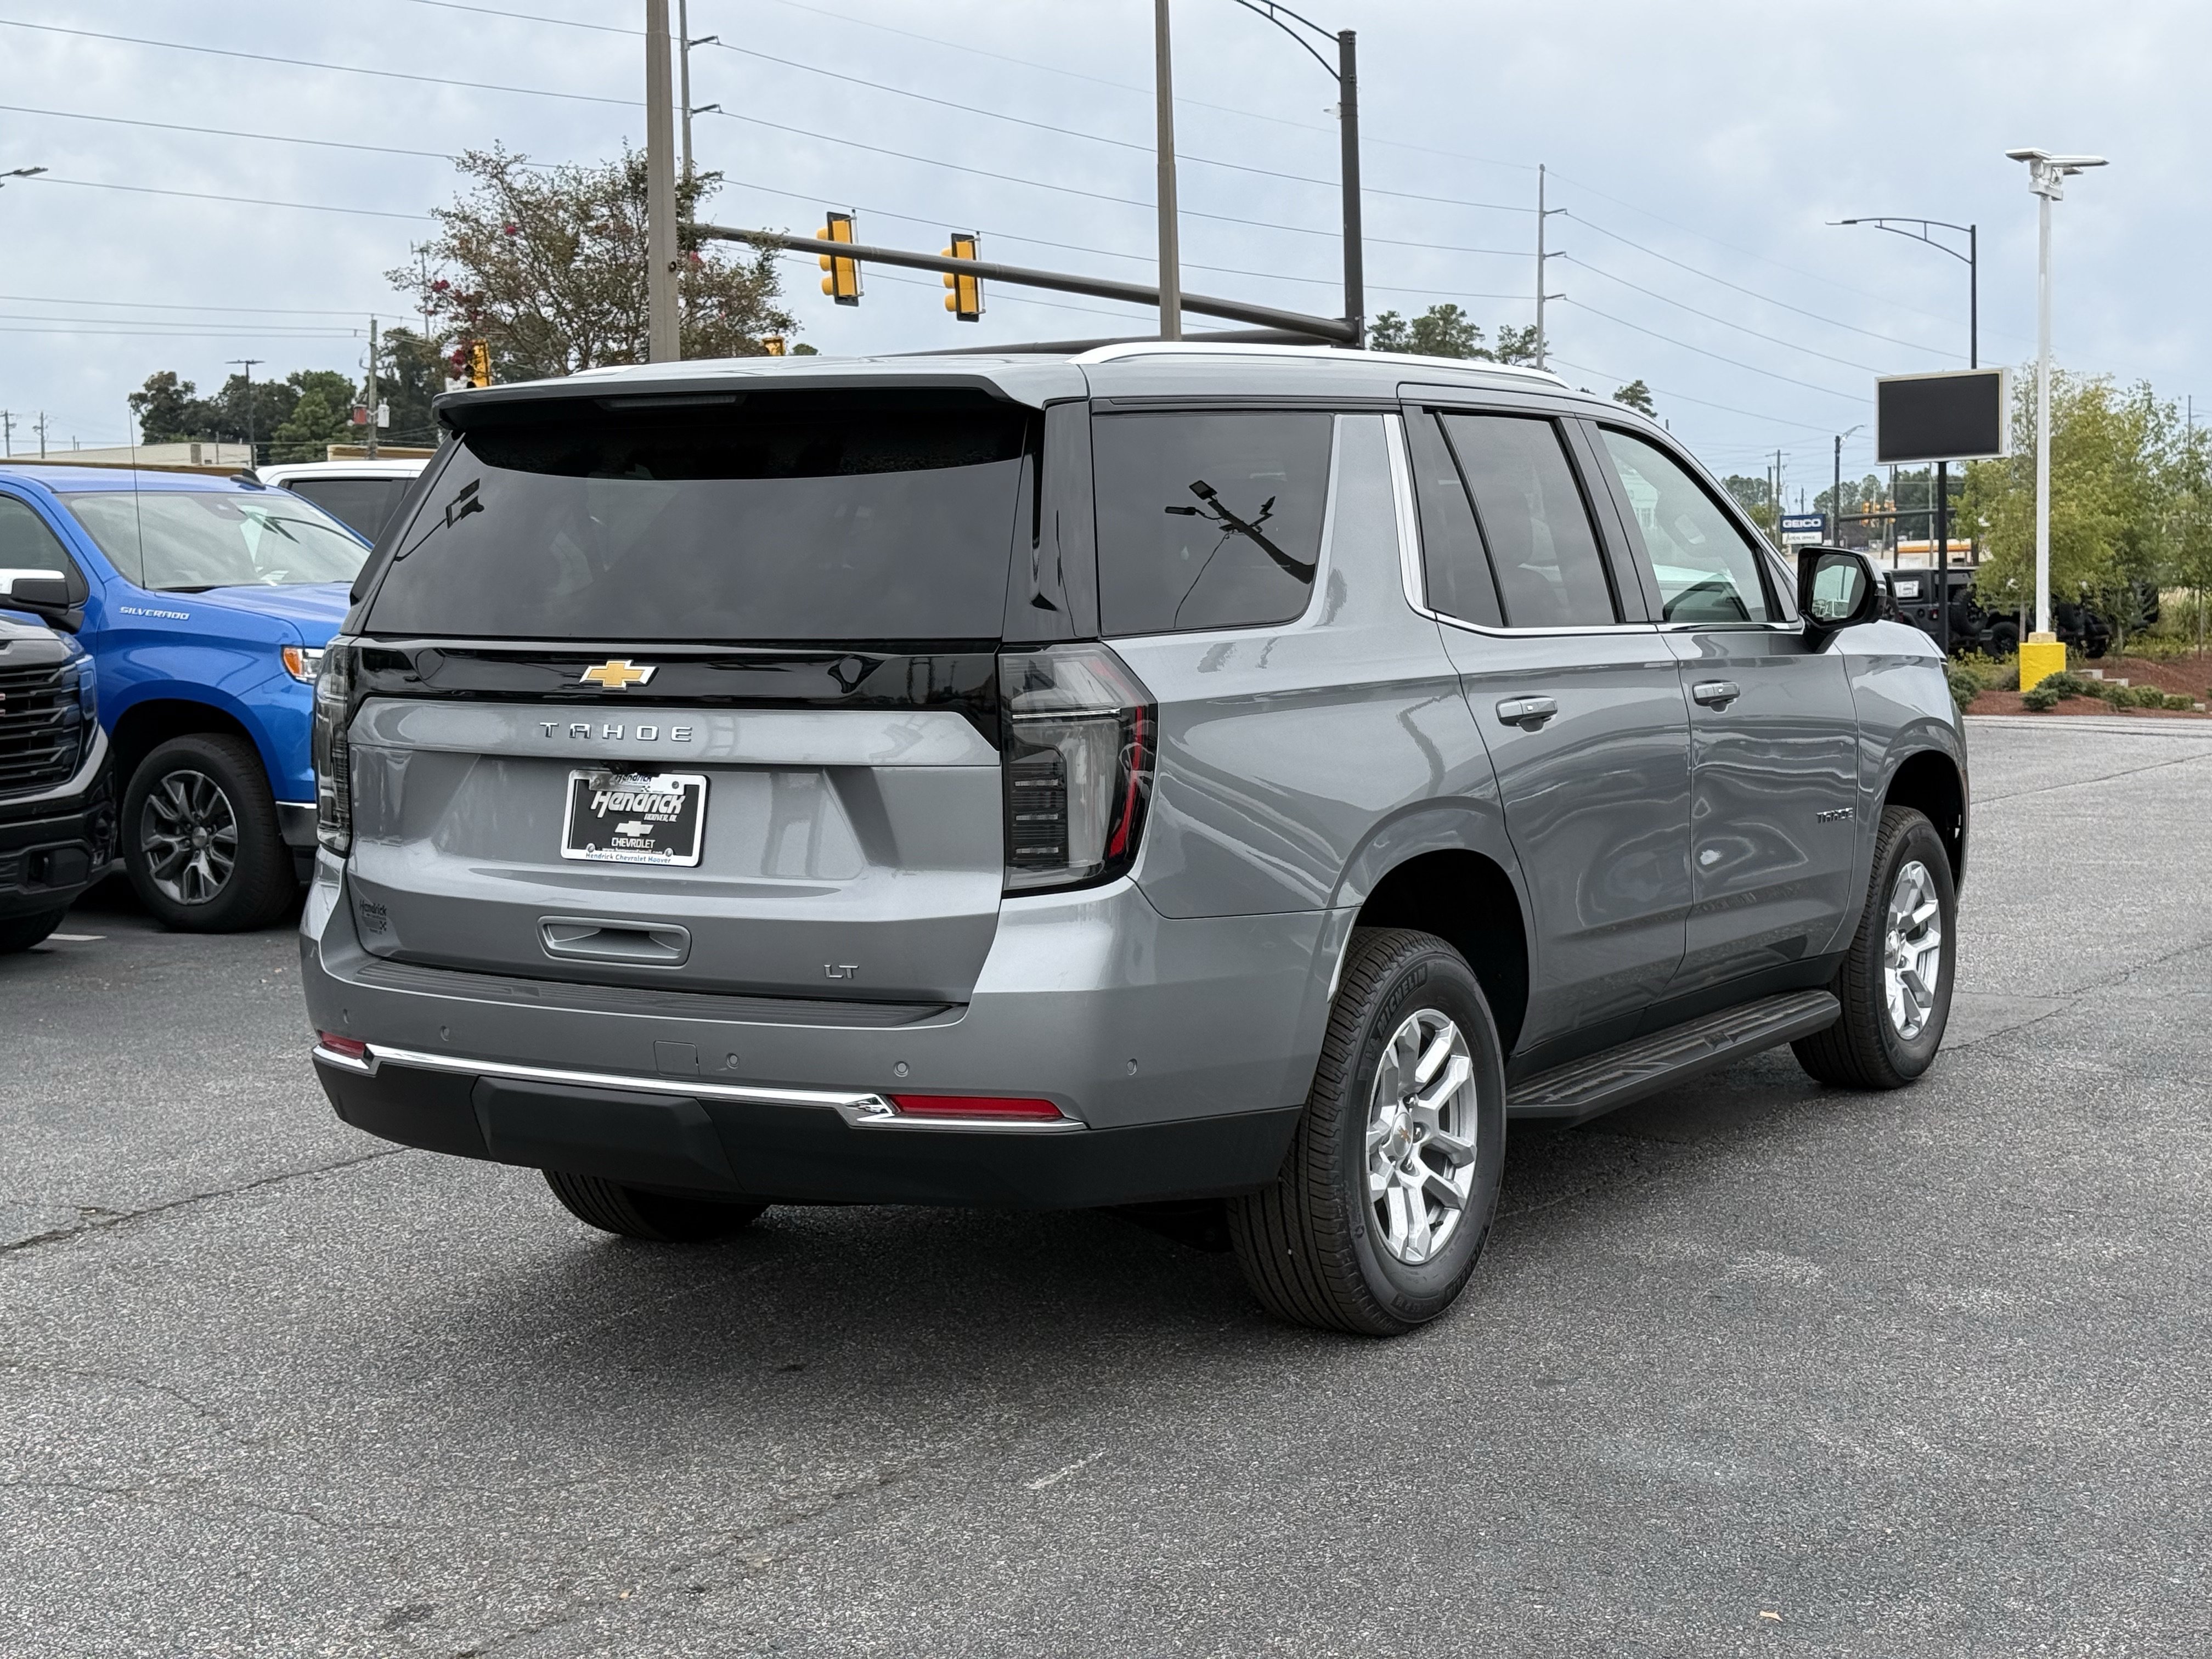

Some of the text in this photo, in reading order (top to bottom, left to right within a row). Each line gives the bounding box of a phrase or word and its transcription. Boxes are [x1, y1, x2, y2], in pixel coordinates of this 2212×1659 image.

[1782, 518, 1821, 528] GEICO
[120, 606, 190, 620] SILVERADO
[539, 722, 692, 741] TAHOE
[590, 791, 686, 818] Hendrick
[611, 837, 656, 849] CHEVROLET
[824, 964, 859, 979] LT
[1376, 966, 1427, 1036] MICHELIN
